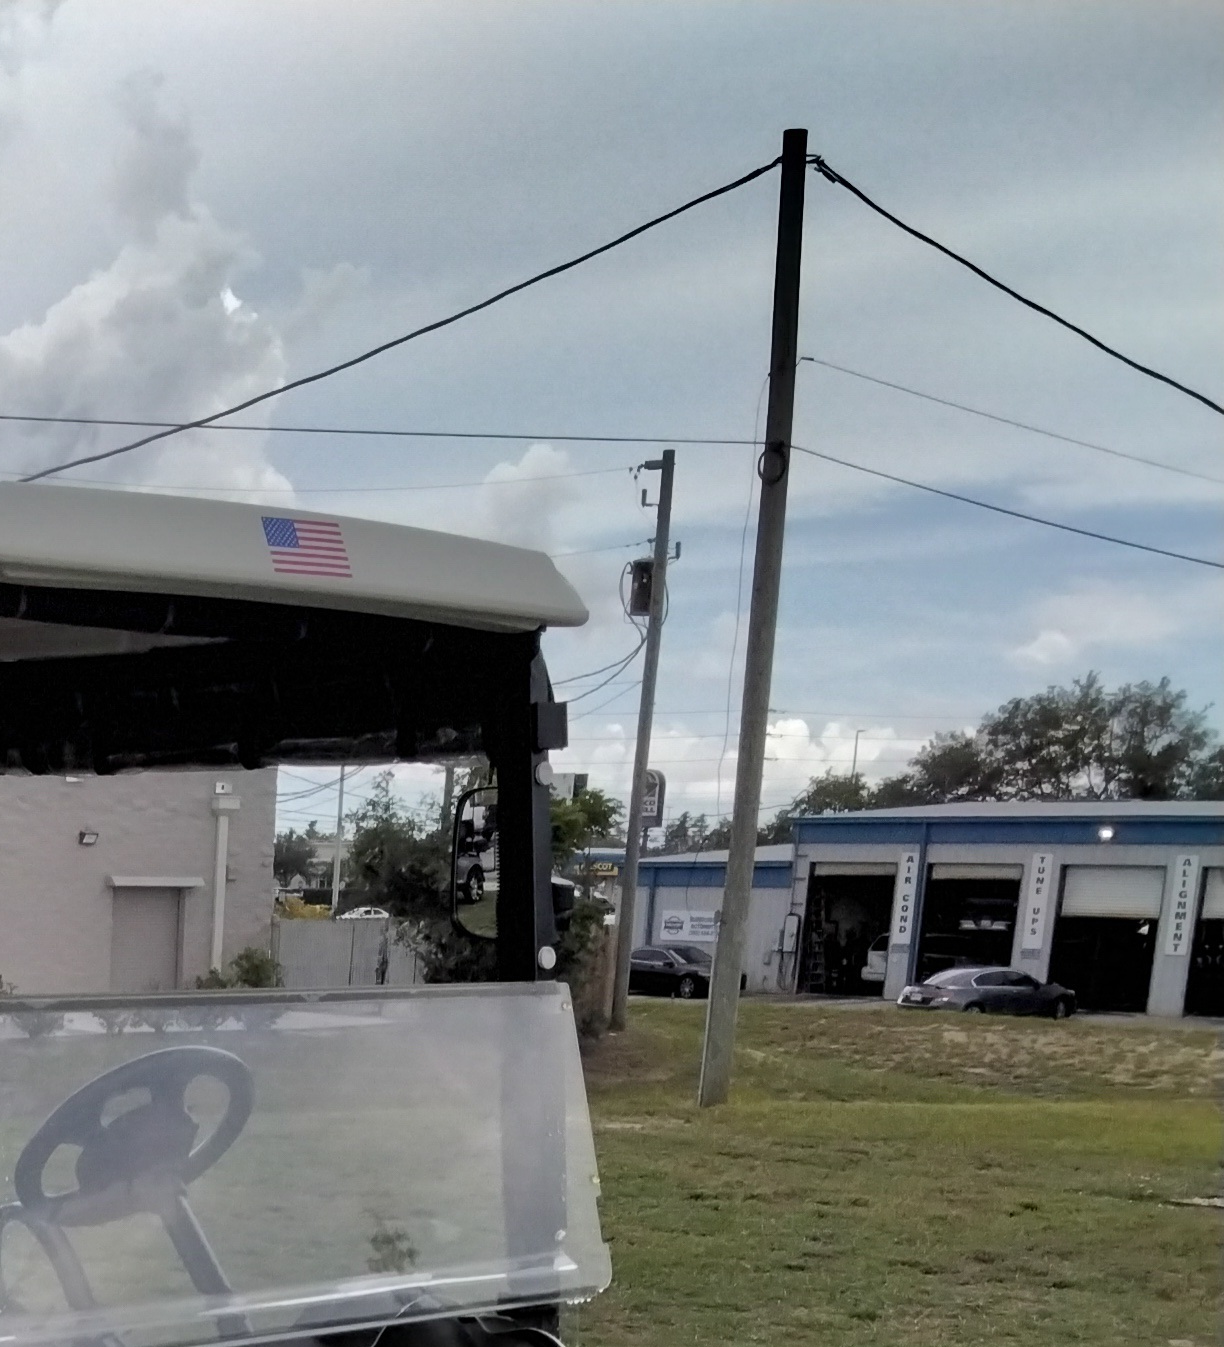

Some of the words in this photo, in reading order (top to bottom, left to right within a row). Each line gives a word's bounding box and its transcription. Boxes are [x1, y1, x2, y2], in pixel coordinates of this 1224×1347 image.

[904, 855, 915, 885] AIR
[1035, 855, 1047, 895] TUNE
[898, 894, 910, 934] COND
[1030, 907, 1041, 936] UPS
[1172, 858, 1192, 952] ALIGNMENT
